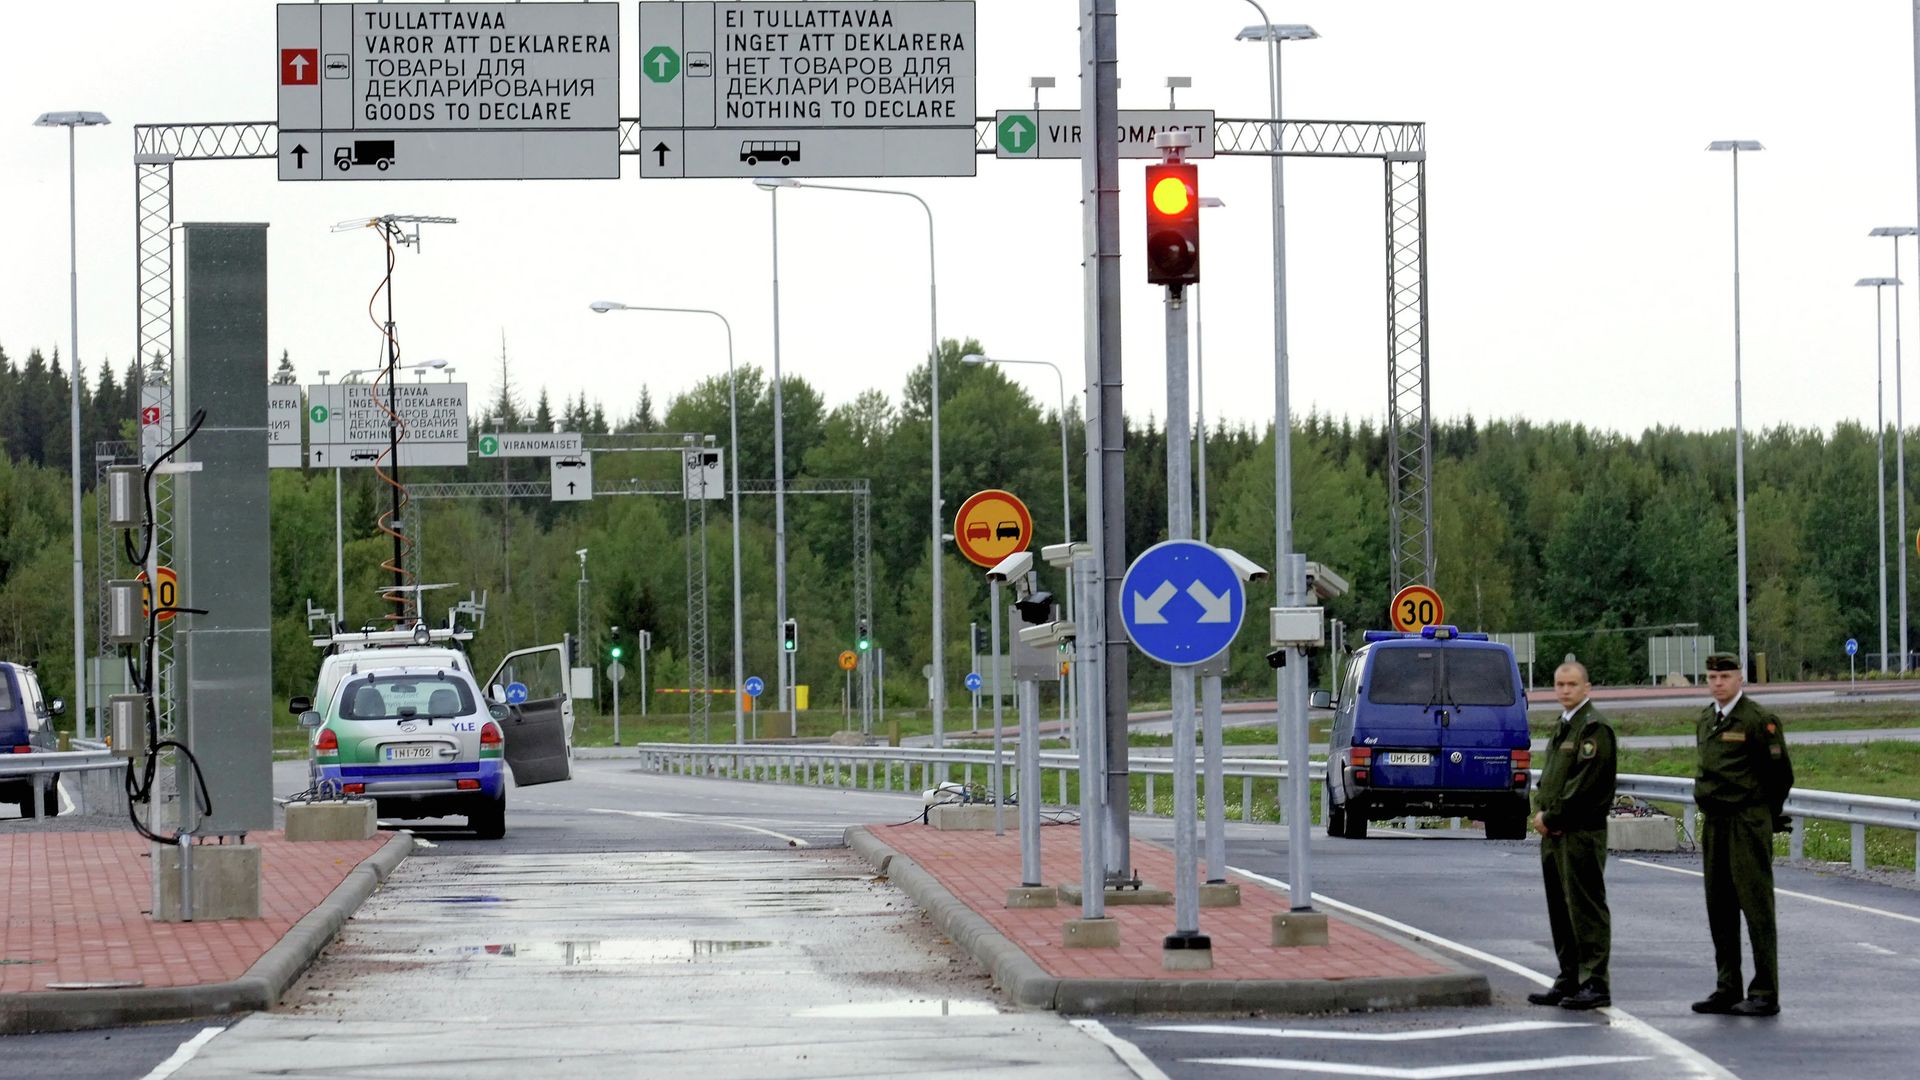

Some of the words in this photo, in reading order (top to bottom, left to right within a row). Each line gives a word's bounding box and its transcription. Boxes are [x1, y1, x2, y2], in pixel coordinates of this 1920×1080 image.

[365, 11, 506, 30] TULLATTAVAA
[726, 10, 744, 28] EI
[753, 10, 893, 28] TULLATTAVAA
[365, 34, 434, 54] VAROR
[443, 34, 481, 53] ATT
[489, 34, 611, 53] DEKLARERA
[726, 33, 789, 52] INGET
[799, 33, 835, 52] ATT
[844, 33, 965, 52] DEKLARERA
[365, 58, 466, 77] ТОВАРЫ
[476, 58, 525, 79] ДЛЯ
[726, 56, 771, 75] НЕТ
[779, 56, 893, 75] ТОВАРОВ
[902, 57, 951, 78] ДЛЯ
[365, 78, 595, 102] ДЕКЛАРИРОВАНИЯ
[365, 102, 435, 121] GOODS
[444, 102, 470, 121] TO
[479, 102, 572, 121] DECLARE
[726, 100, 821, 119] NOTHING
[830, 100, 855, 119] TO
[864, 100, 956, 119] DECLARE
[349, 387, 357, 397] EI
[362, 387, 428, 397] TULLATAVAA
[383, 399, 401, 408] AT
[405, 398, 462, 408] DEKLARERA
[350, 410, 370, 419] НЕТ
[374, 409, 429, 419] ТОАРОВ
[433, 409, 456, 419] ДЛЯ
[414, 429, 459, 439] DECLARE
[502, 440, 578, 450] VIRANOMAISET
[1401, 600, 1434, 625] 30
[451, 722, 476, 732] YLE
[394, 748, 431, 757] INI-702
[1390, 754, 1428, 763] UMI-618
